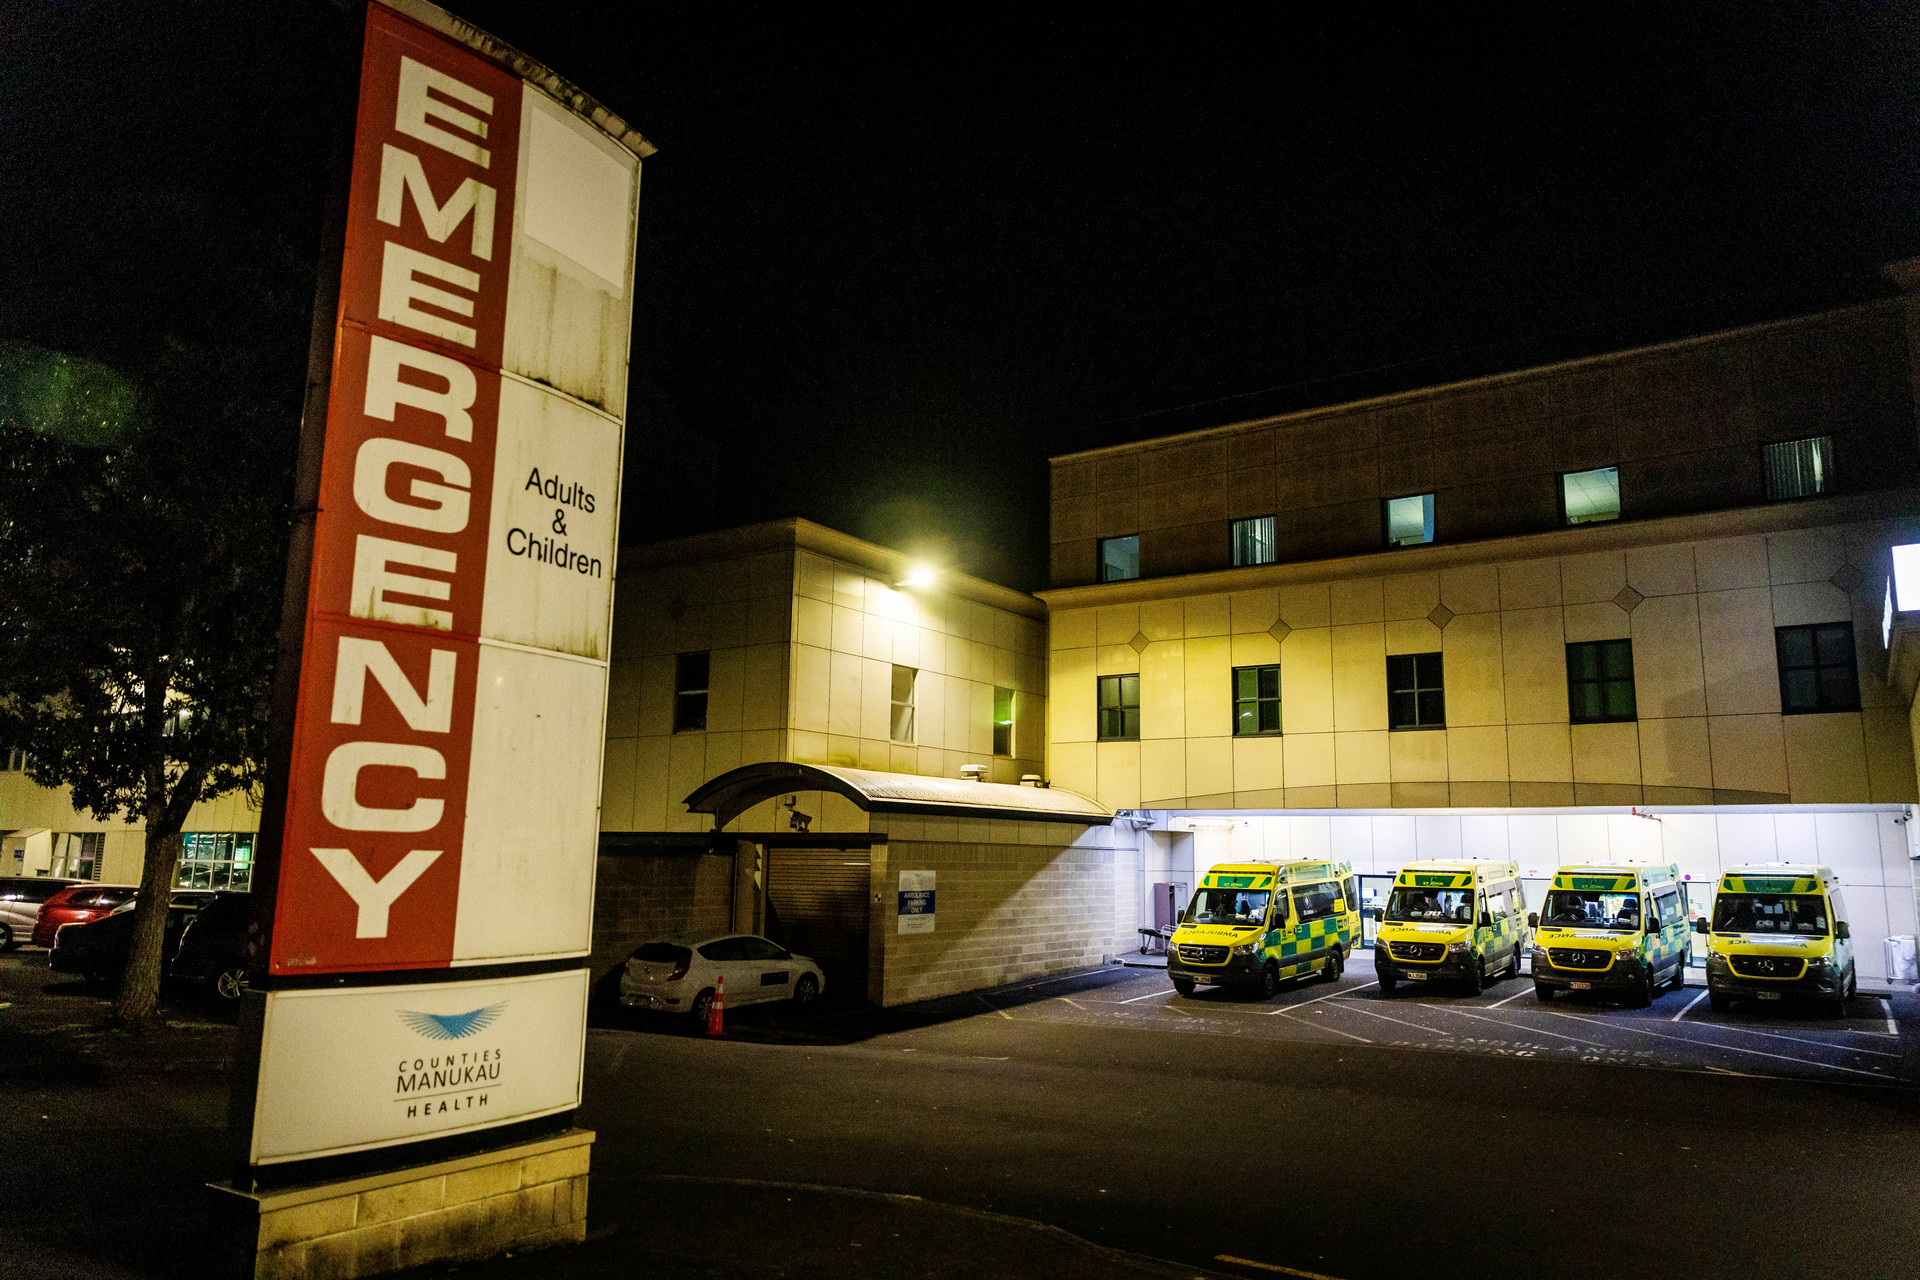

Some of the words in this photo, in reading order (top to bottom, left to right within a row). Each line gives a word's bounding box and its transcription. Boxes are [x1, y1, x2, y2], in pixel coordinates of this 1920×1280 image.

[309, 55, 497, 939] EMERGENCY
[525, 467, 596, 513] Adults
[552, 508, 567, 536] &
[507, 528, 602, 579] Children
[399, 1048, 501, 1073] COUNTIES
[396, 1061, 501, 1094] MANUKAU
[407, 1094, 488, 1118] HEALTH
